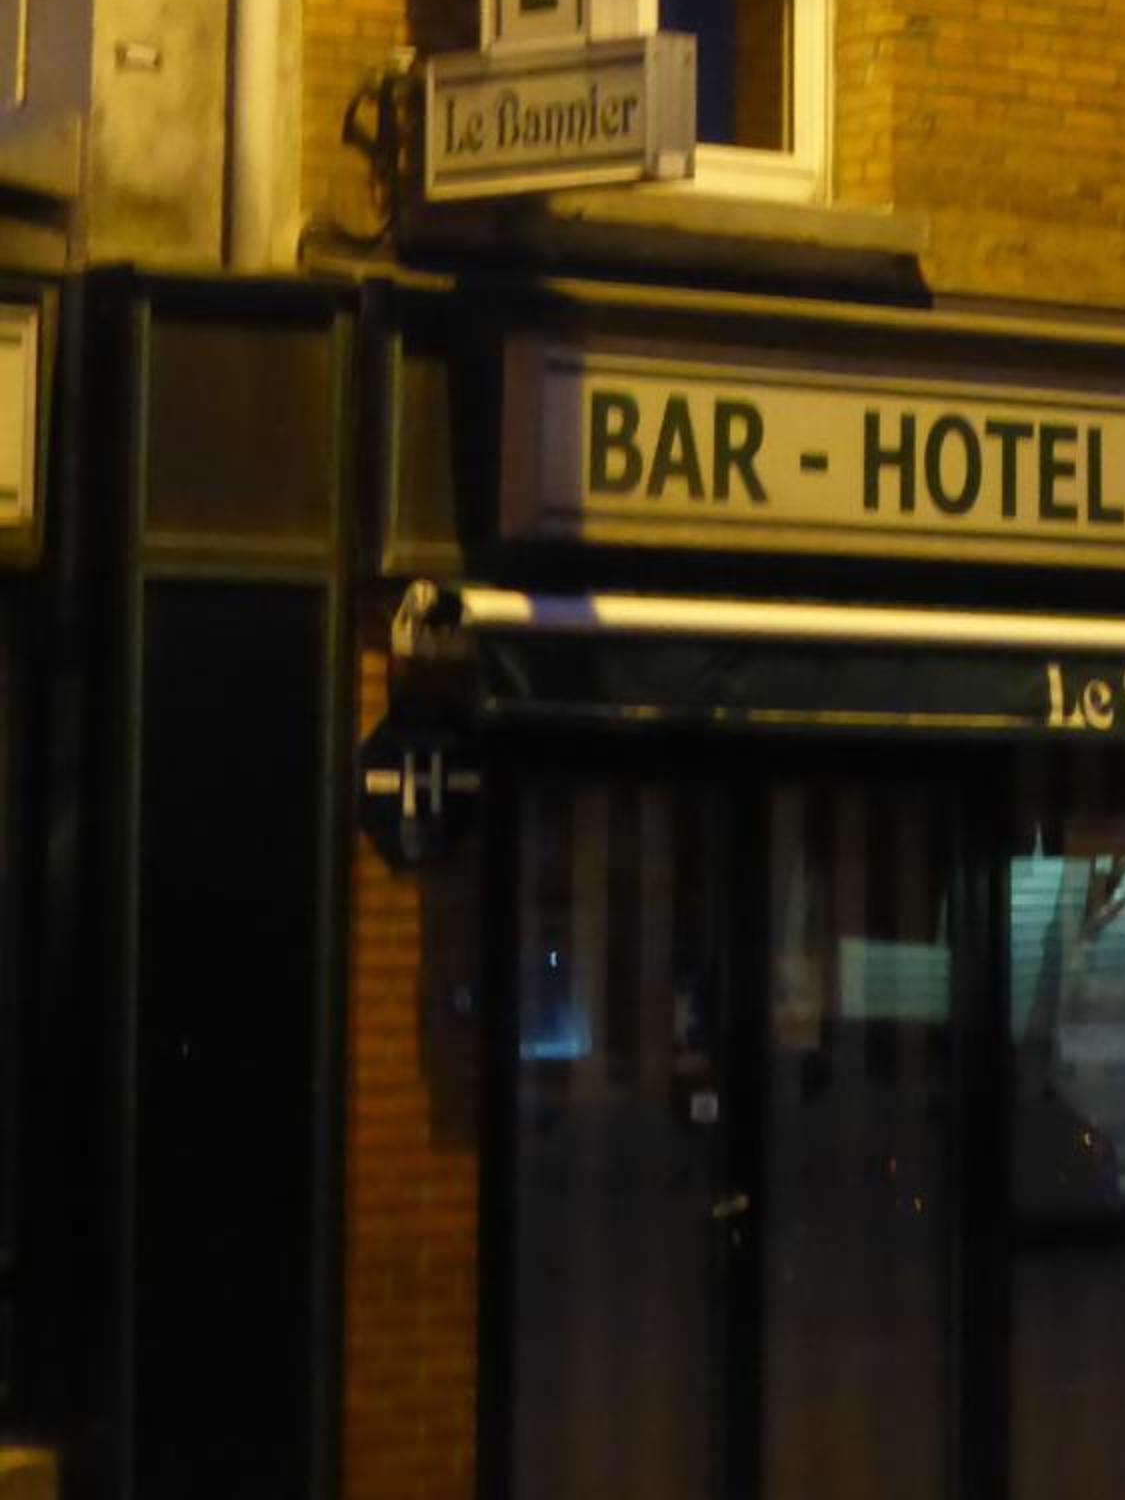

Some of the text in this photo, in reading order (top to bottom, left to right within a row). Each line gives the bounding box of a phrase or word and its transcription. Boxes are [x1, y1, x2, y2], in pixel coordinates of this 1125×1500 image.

[446, 84, 638, 153] Le Bannier
[589, 388, 768, 504] BAR
[862, 408, 1125, 525] HOTEL
[1046, 661, 1114, 729] Le
